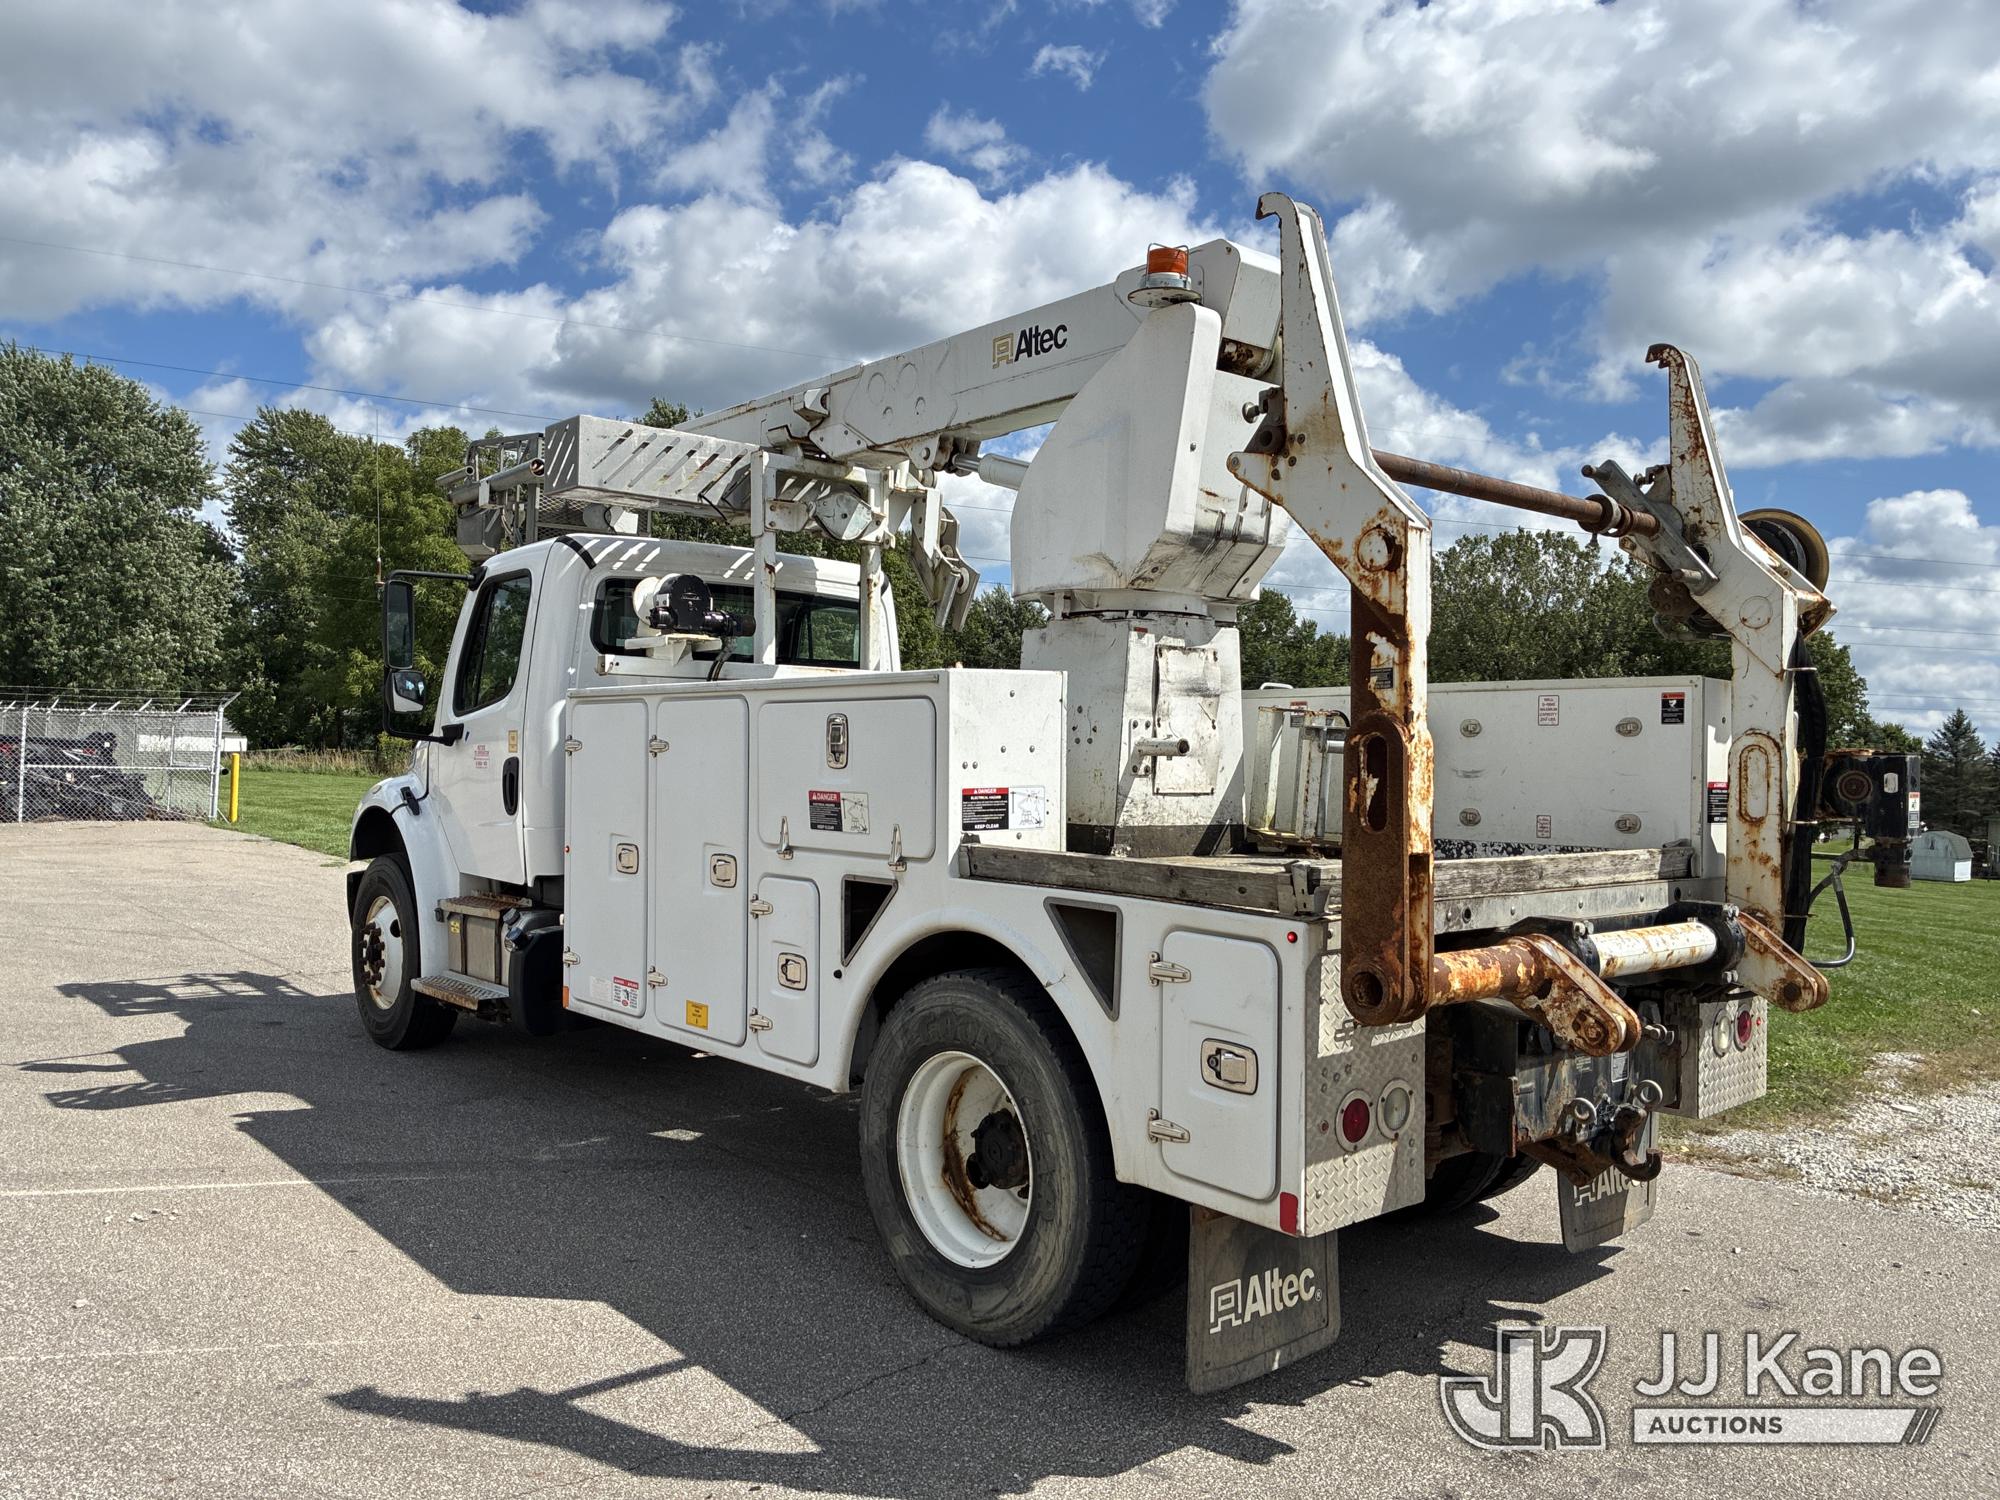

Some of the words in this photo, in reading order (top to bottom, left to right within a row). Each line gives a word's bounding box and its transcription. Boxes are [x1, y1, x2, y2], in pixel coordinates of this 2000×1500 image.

[1014, 324, 1068, 363] Altec
[816, 792, 837, 801] DANGER
[1597, 1164, 1641, 1201] Alte
[1243, 1267, 1316, 1324] Altec
